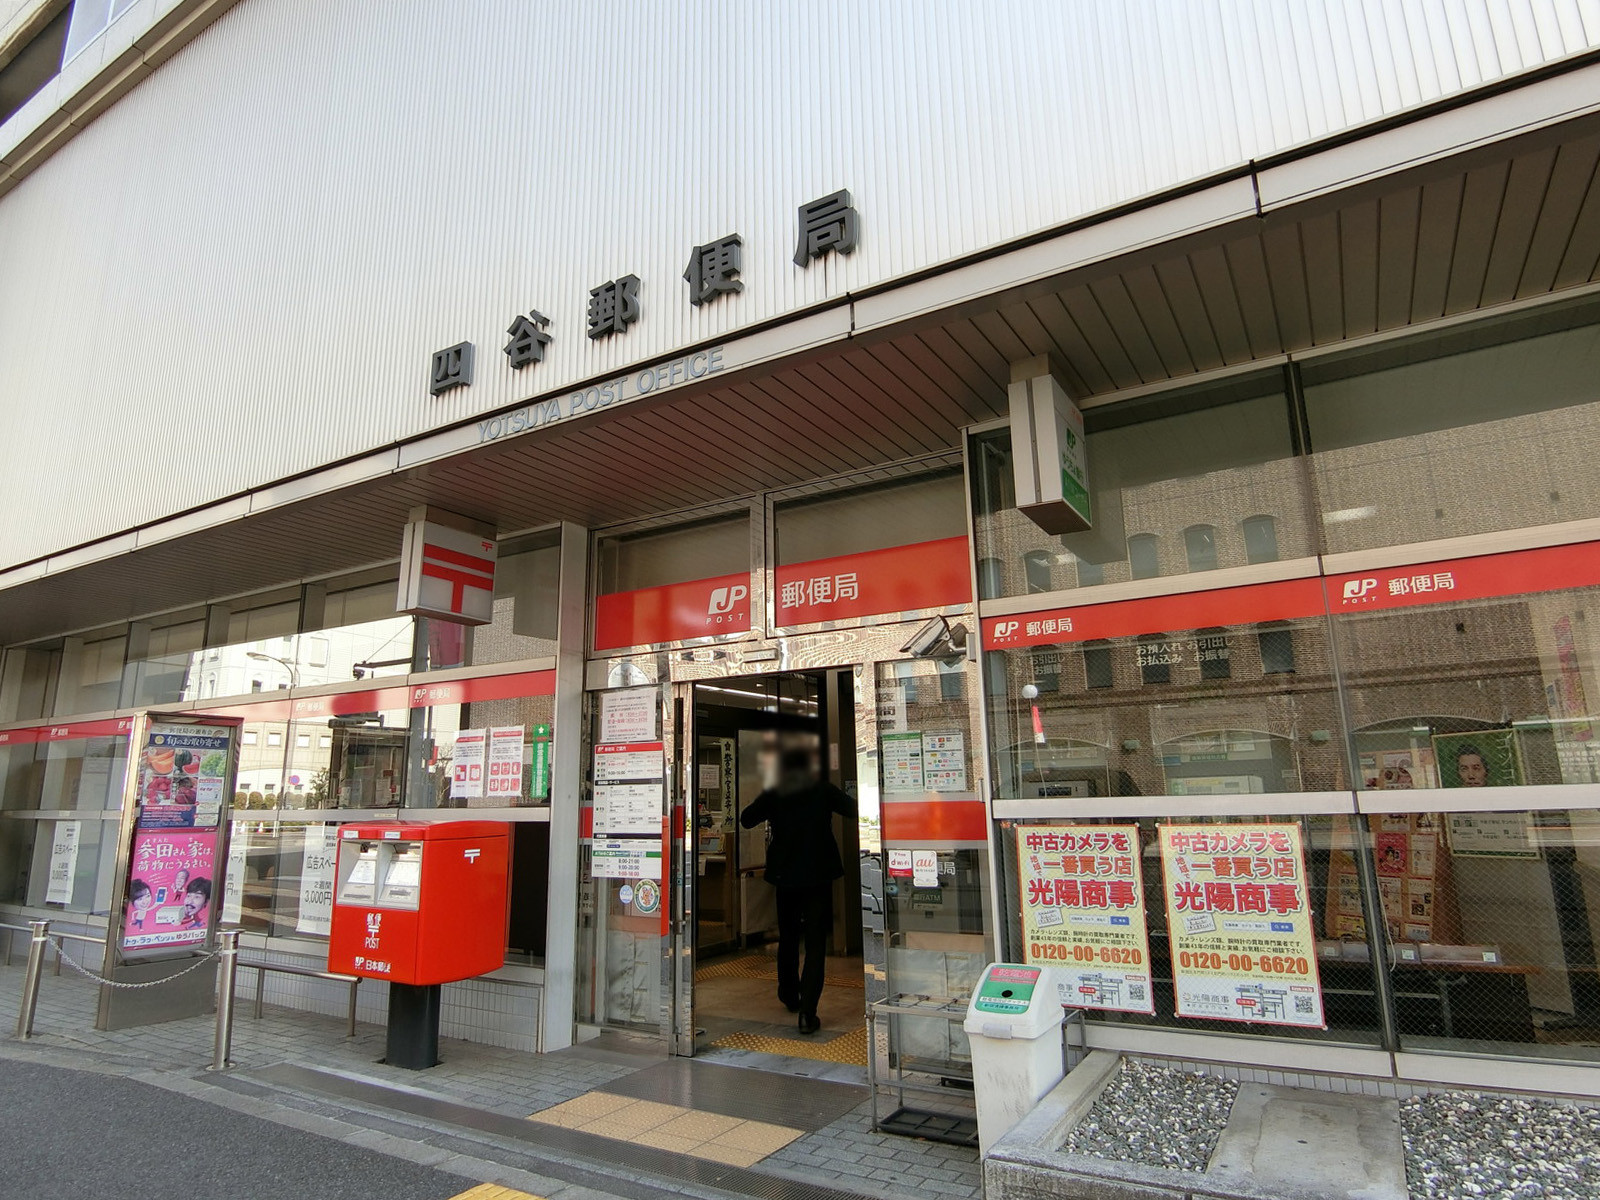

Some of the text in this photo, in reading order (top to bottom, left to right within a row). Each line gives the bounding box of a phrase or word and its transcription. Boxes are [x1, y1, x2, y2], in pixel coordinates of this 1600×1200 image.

[430, 188, 859, 397] 四谷郵便局
[477, 345, 726, 443] YOTSUYA POST OFFICE
[781, 572, 860, 610] 郵便局
[1342, 578, 1378, 598] JP
[1388, 572, 1455, 596] 郵便局
[707, 584, 747, 615] JP
[1342, 595, 1377, 605] POST
[706, 612, 744, 625] POST
[1026, 617, 1073, 637] 郵便局
[994, 620, 1019, 638] JP
[1136, 642, 1182, 655] お預入れ
[1187, 636, 1234, 650] お引出し
[1136, 654, 1182, 667] お払込み
[1194, 649, 1231, 662] お振替
[1026, 833, 1129, 851] 中古カメラを
[1170, 832, 1290, 852] 中古カメラを
[137, 859, 211, 871] 荷物にうるさい。
[916, 859, 934, 867] au
[1043, 855, 1132, 875] 一番買う店
[1175, 856, 1190, 879] 地域で
[1191, 857, 1294, 877] 一番買う店
[304, 890, 332, 905] 3,000円
[1028, 878, 1136, 908] 光陽商事
[1174, 881, 1300, 914] 光陽商事
[367, 913, 382, 926] 郵便
[365, 937, 380, 949] POST
[1031, 943, 1142, 965] 0120-00-6620
[1180, 951, 1309, 975] 0120-00-6620
[365, 960, 391, 973] 日本郵便
[1193, 993, 1229, 1003] 光陽商事
